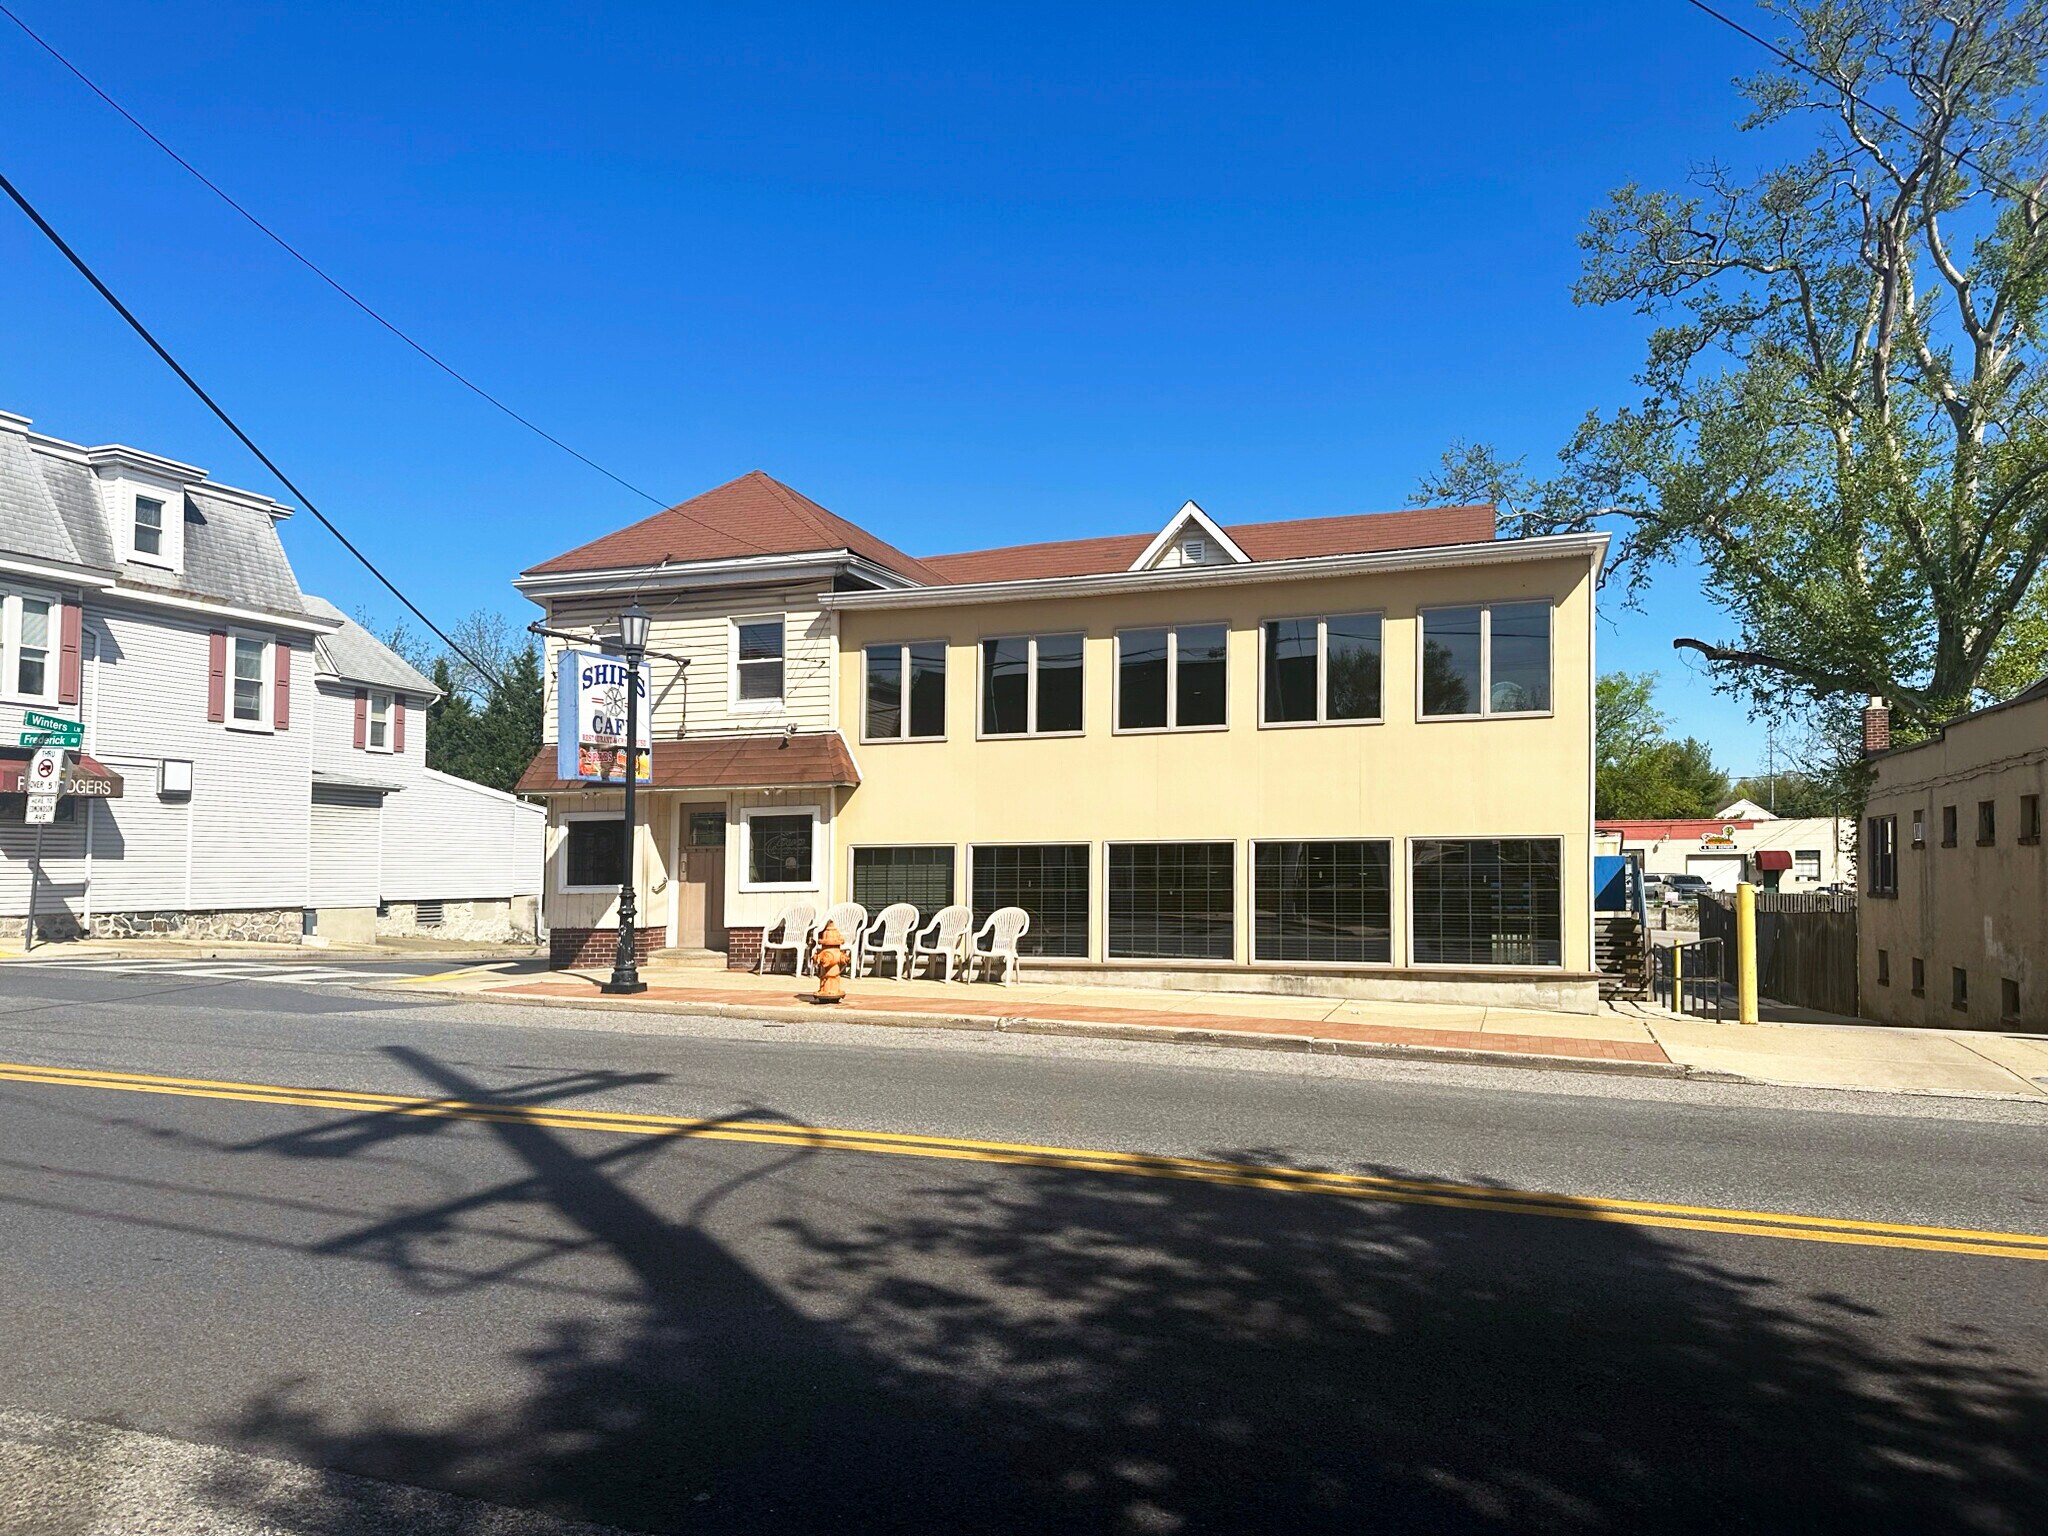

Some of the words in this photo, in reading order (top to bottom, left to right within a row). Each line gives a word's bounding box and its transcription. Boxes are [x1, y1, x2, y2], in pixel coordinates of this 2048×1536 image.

[32, 715, 68, 732] Winters
[592, 715, 629, 737] CAF
[23, 734, 66, 745] Frederick
[42, 750, 56, 758] THRU
[30, 781, 44, 789] OVER
